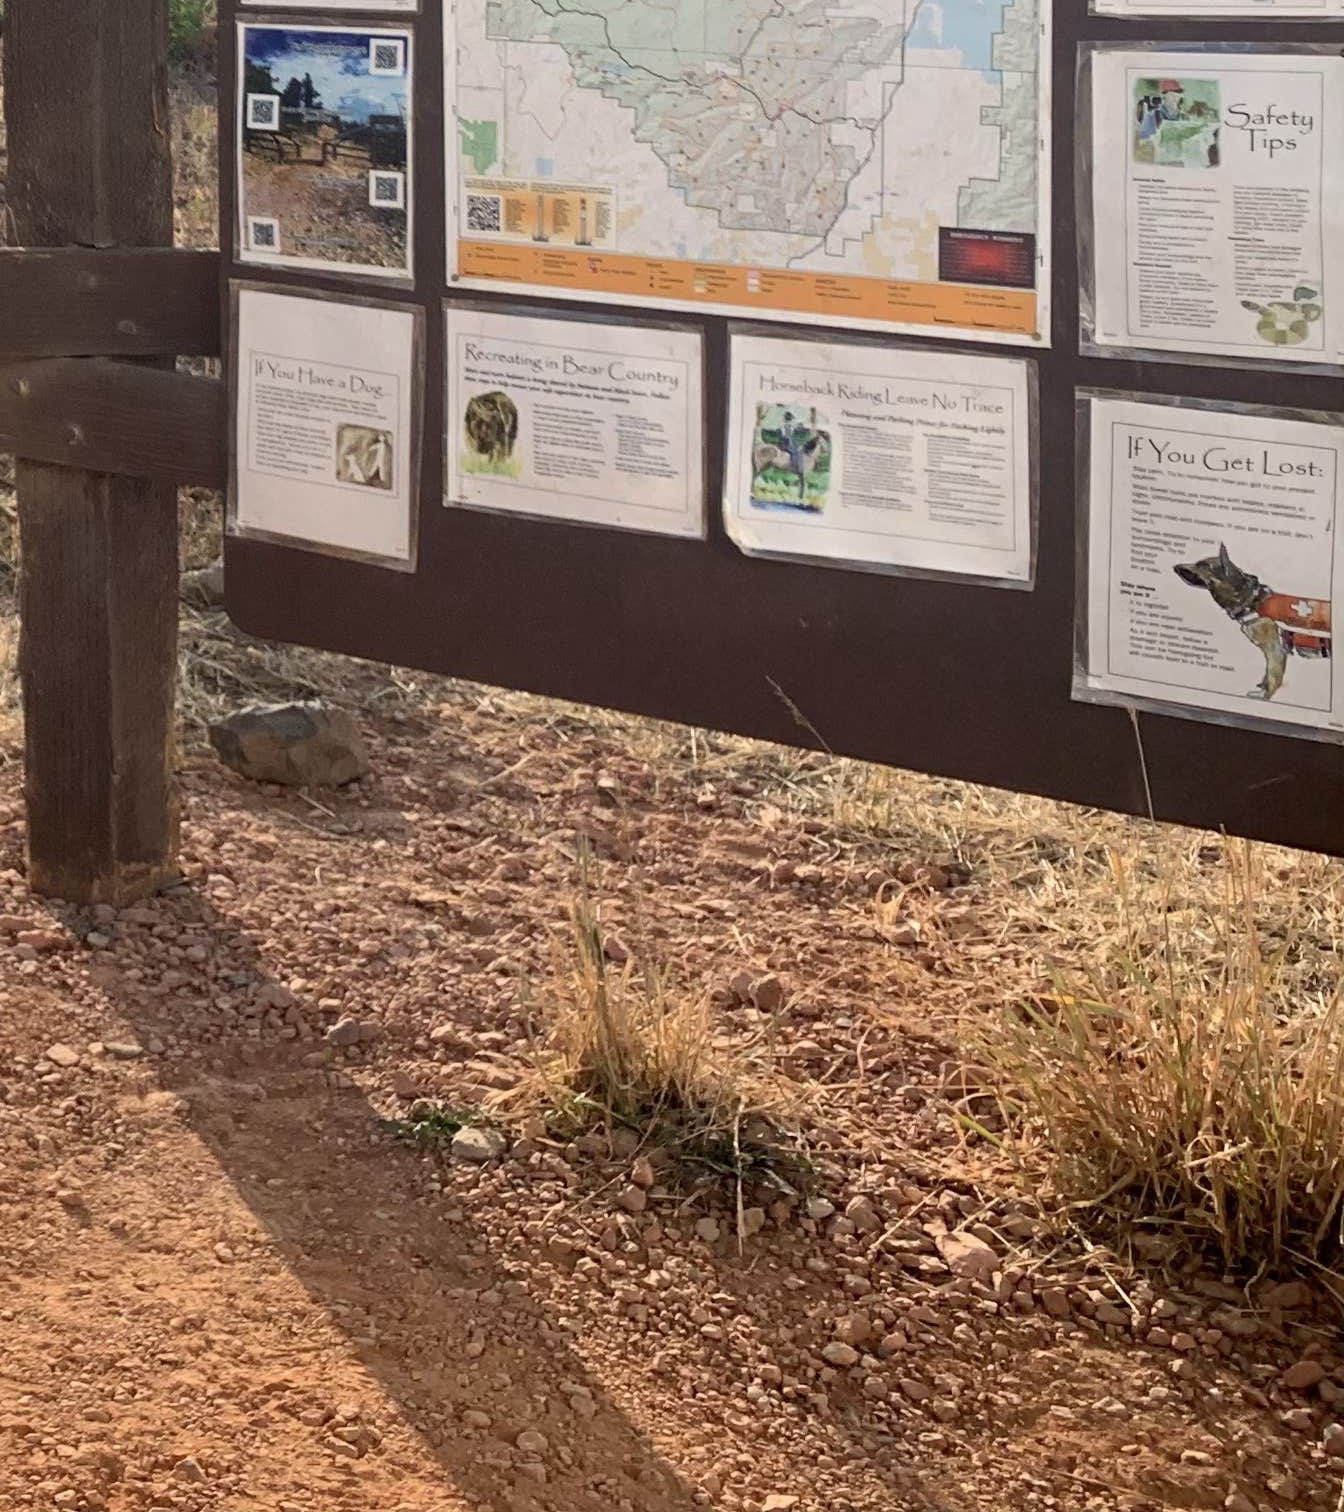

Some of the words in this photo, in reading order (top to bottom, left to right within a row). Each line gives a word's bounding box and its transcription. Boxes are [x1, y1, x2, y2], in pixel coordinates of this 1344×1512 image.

[1223, 103, 1313, 135] Safety
[1241, 128, 1297, 159] Tips
[254, 358, 264, 376] If
[267, 360, 294, 379] You
[298, 366, 336, 386] Have
[338, 380, 346, 388] a
[464, 342, 544, 374] Recreating
[545, 359, 559, 369] in
[562, 354, 608, 376] Bear
[608, 361, 679, 391] Country
[759, 375, 835, 397] Horseback
[838, 383, 882, 406] Riding
[885, 387, 928, 406] Leave
[932, 393, 957, 410] No
[962, 395, 1004, 415] Trace
[1127, 435, 1143, 459] If
[1148, 437, 1195, 465] You
[1202, 447, 1254, 472] Get
[1263, 450, 1324, 478] Lost:
